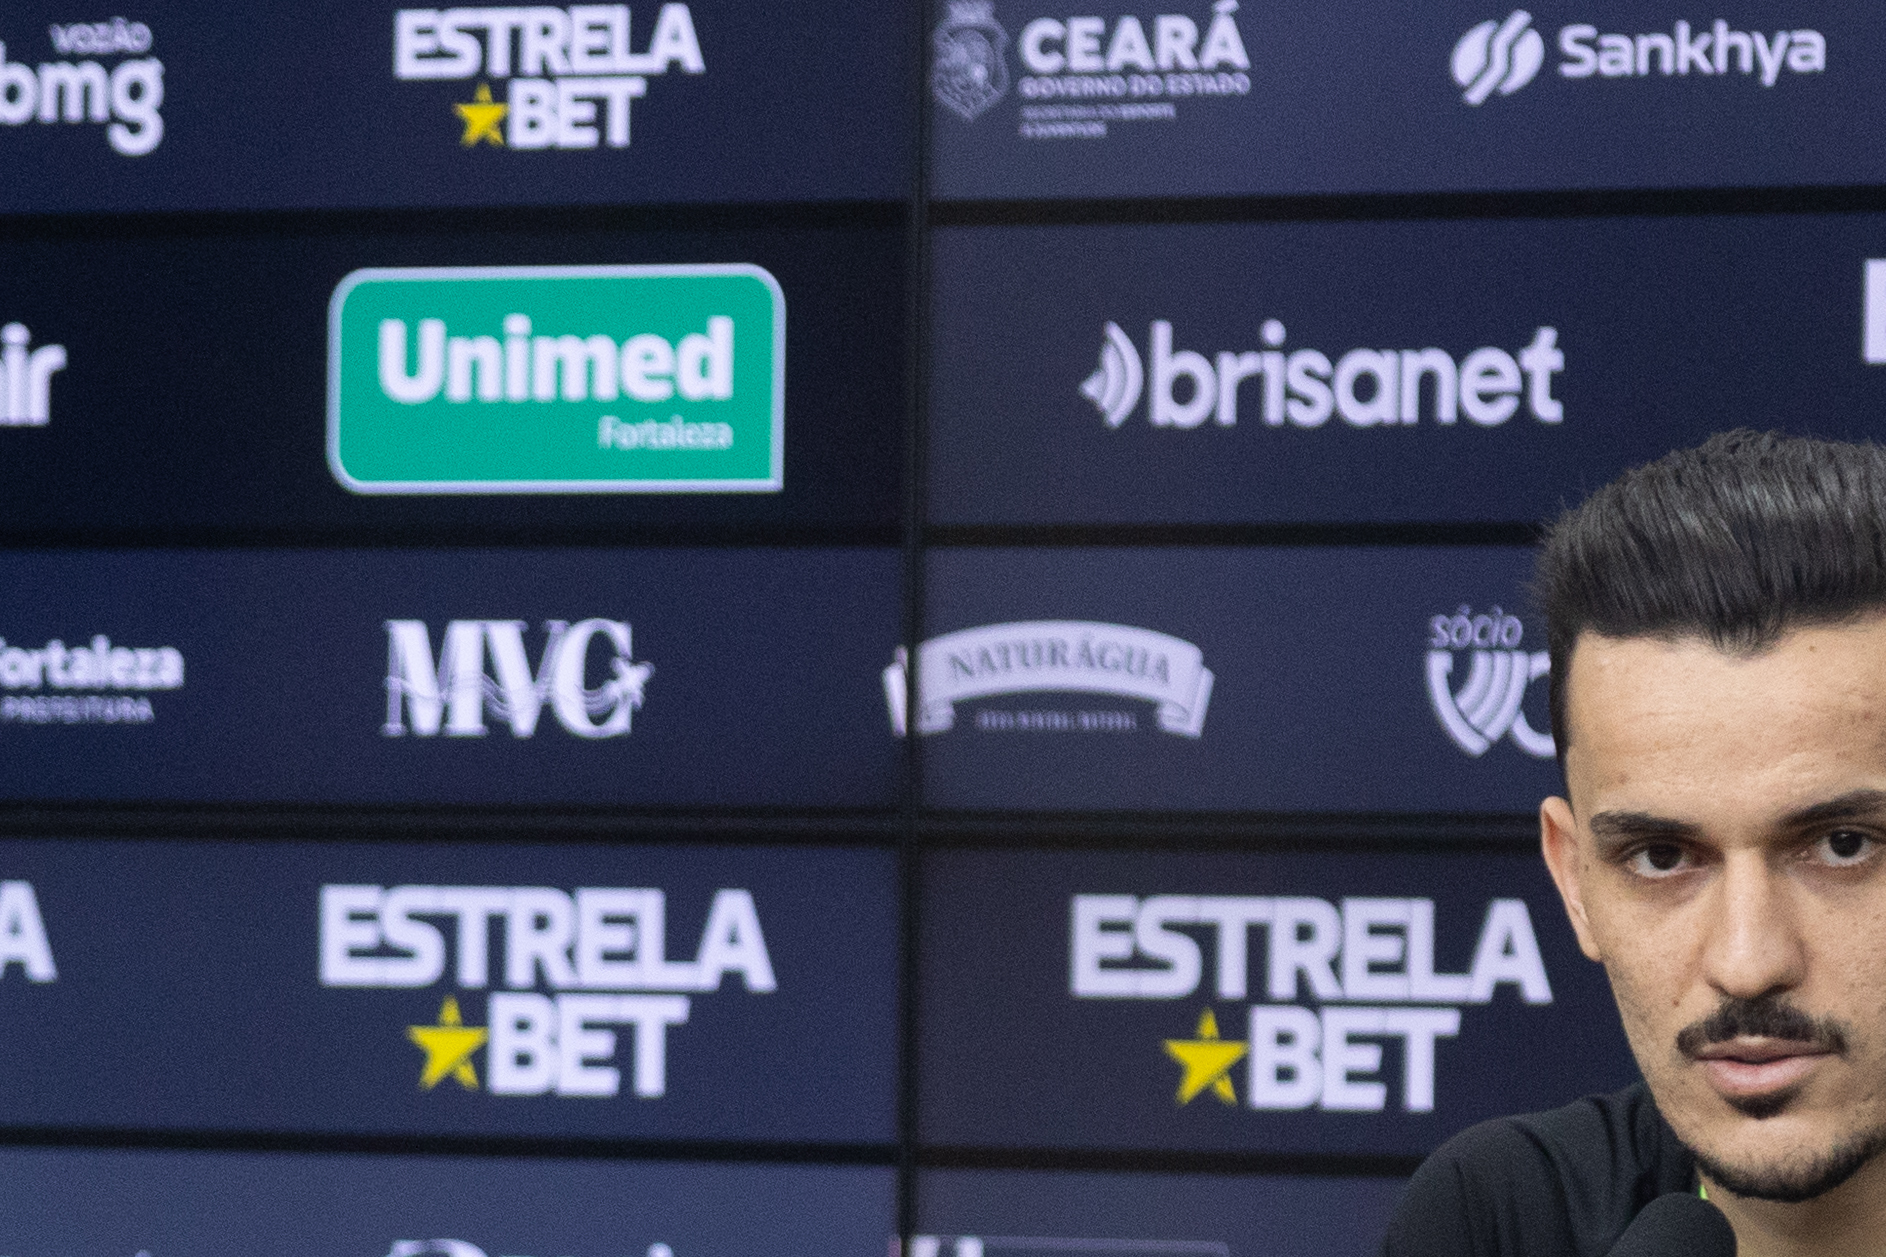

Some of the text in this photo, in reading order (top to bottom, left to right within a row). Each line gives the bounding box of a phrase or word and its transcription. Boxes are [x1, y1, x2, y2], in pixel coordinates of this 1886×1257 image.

[394, 3, 706, 77] ESTRELA
[1018, 0, 1250, 72] CEARÁ
[1559, 20, 1826, 86] Sankhya
[0, 40, 165, 156] bmg
[507, 78, 647, 149] BET
[0, 323, 66, 426] ir
[379, 314, 734, 404] Unimed
[1149, 320, 1564, 428] brisanet
[598, 415, 733, 450] Fortaleza
[0, 635, 184, 689] ortaleza
[380, 617, 636, 737] MVC
[947, 630, 1172, 687] NATURÁGUA
[319, 884, 778, 992] ESTRELA
[1070, 894, 1554, 1003] ESTRELA
[486, 992, 691, 1097] BET
[1249, 1004, 1462, 1111] BET
